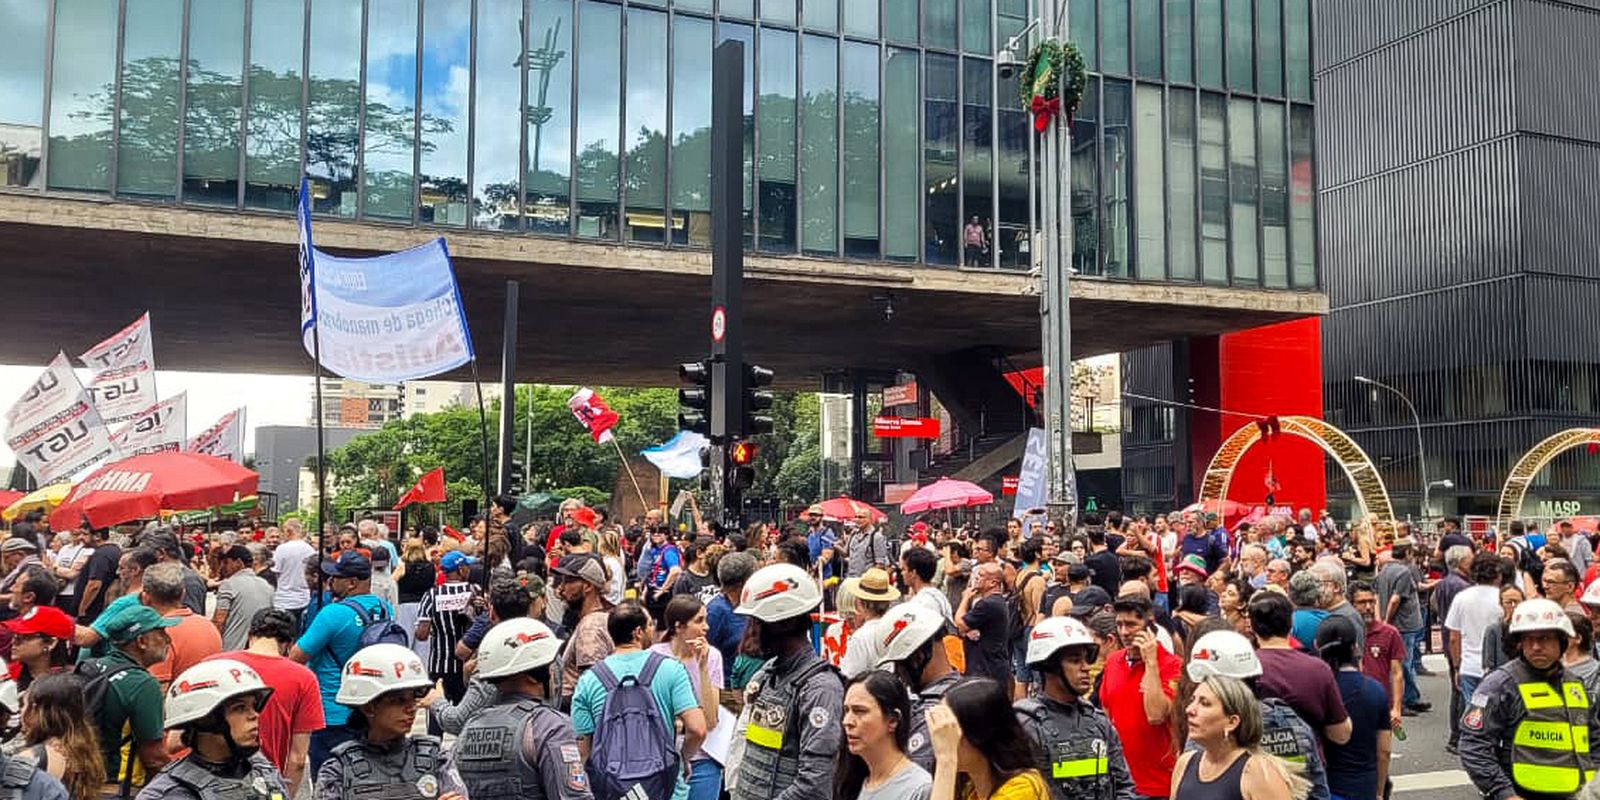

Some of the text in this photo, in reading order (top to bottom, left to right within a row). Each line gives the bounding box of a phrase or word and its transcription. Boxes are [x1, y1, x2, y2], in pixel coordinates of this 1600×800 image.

[1540, 500, 1581, 518] MASP
[394, 661, 405, 679] P
[1261, 730, 1295, 744] OLÍCIA
[463, 741, 501, 757] MILITAR
[1263, 741, 1298, 754] ILITAR
